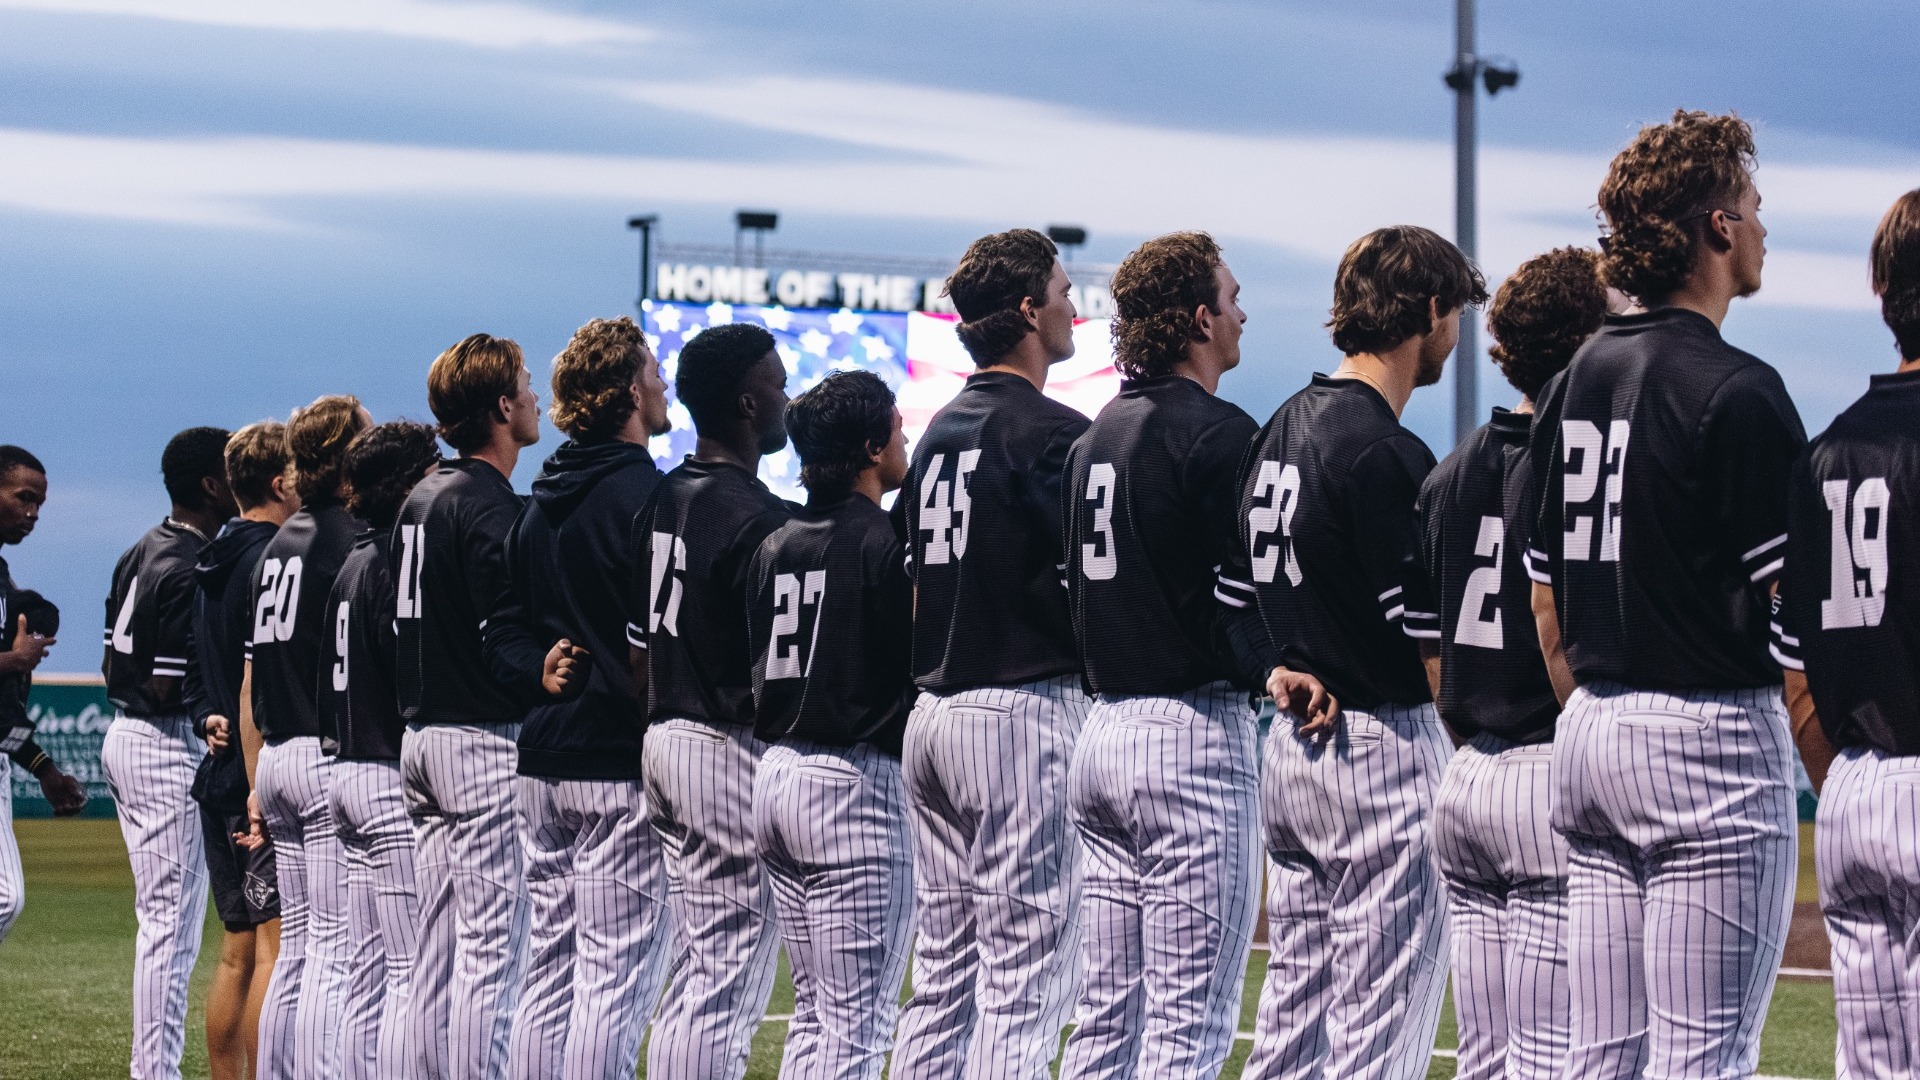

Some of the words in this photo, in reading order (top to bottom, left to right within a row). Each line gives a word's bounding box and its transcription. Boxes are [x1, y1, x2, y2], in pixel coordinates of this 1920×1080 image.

[657, 263, 769, 303] HOME
[776, 270, 830, 307] OF
[838, 273, 917, 311] THE
[919, 449, 982, 564] 45
[1083, 463, 1117, 580] 3
[1562, 420, 1630, 562] 22
[253, 555, 303, 645] 20
[1454, 515, 1504, 650] 2
[1821, 477, 1891, 630] 19
[332, 600, 350, 692] 9
[765, 569, 827, 681] 27
